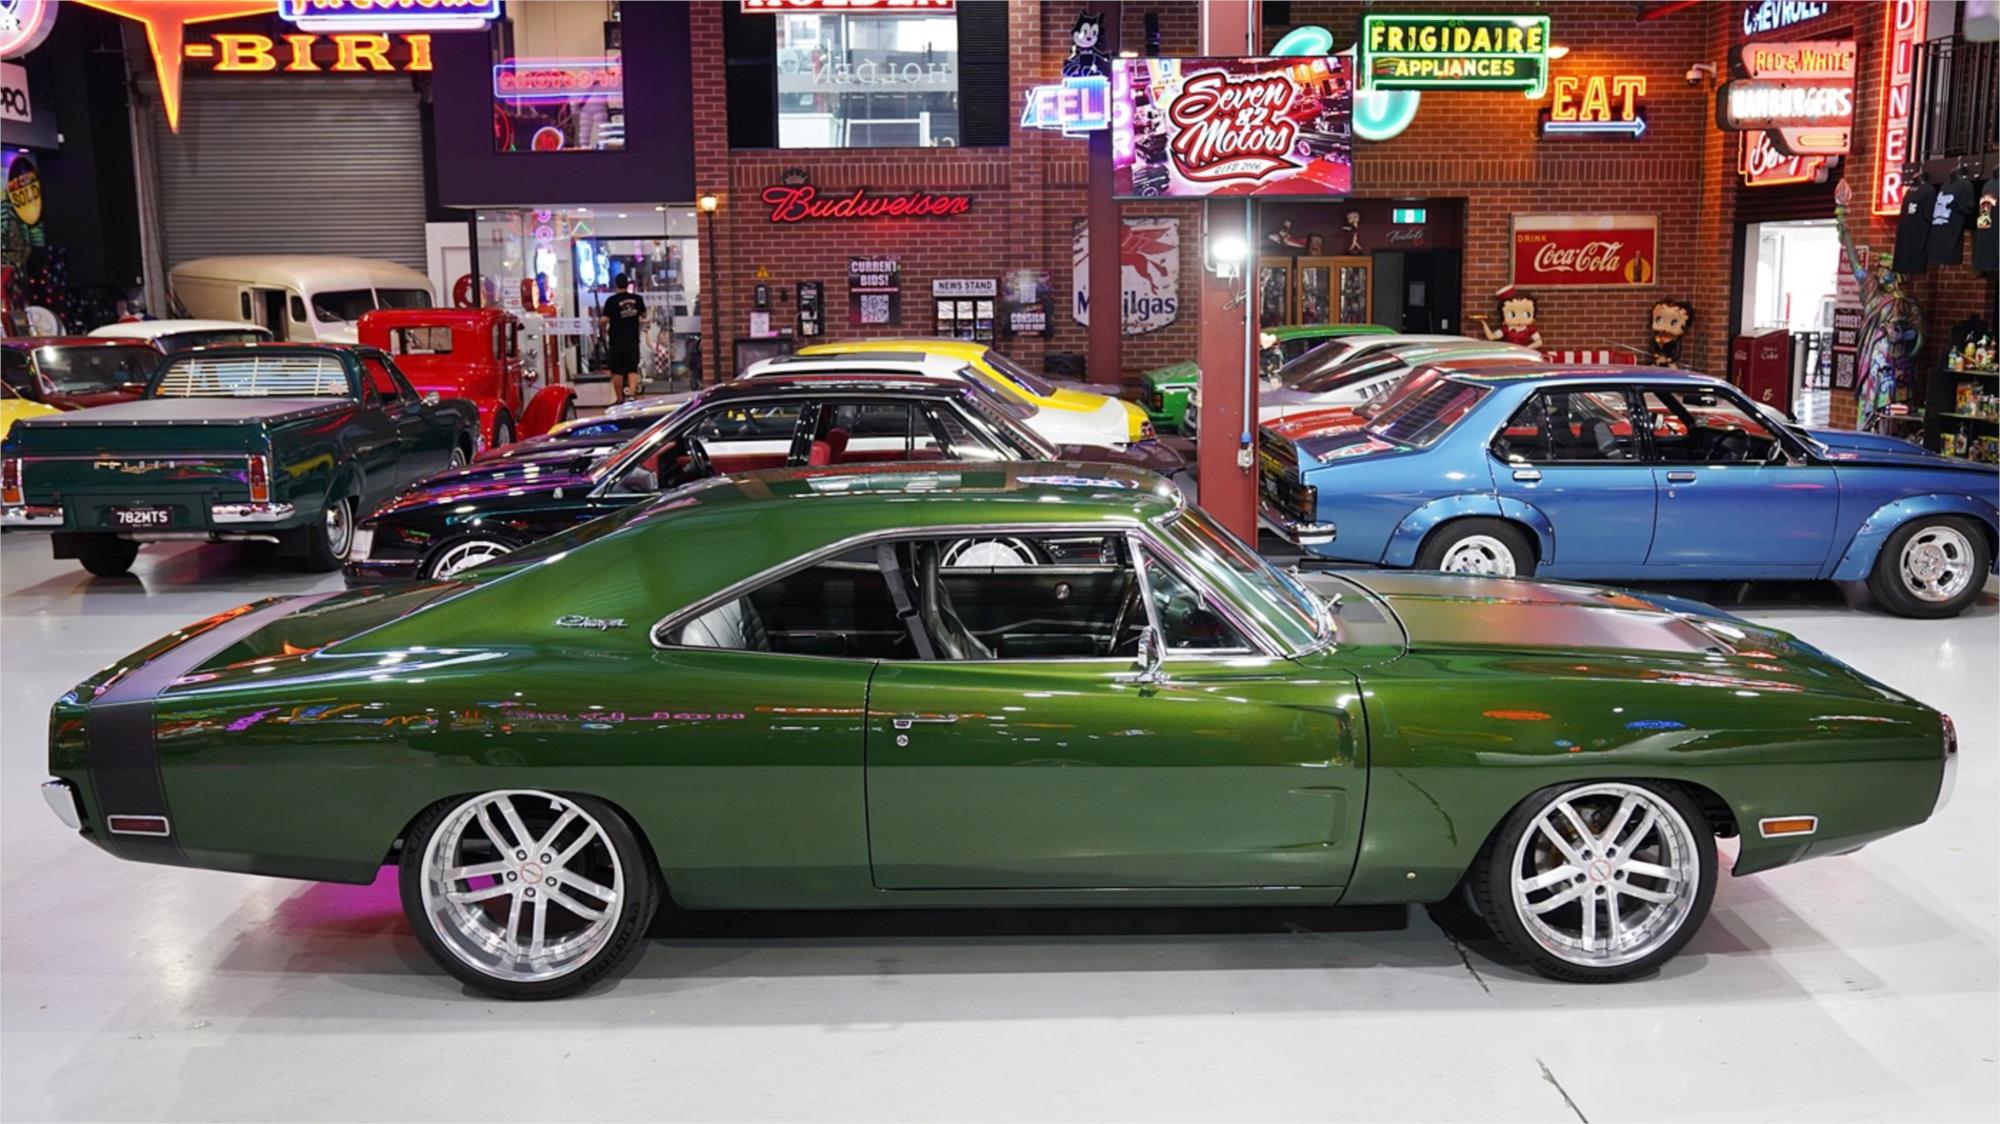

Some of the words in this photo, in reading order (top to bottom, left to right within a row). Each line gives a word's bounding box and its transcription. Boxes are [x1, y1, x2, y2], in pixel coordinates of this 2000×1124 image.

[1370, 26, 1543, 51] FRIGIDAIRE
[1394, 59, 1515, 77] APPLIANCES
[1755, 51, 1782, 71] RED
[1801, 49, 1850, 71] WHITE
[1175, 78, 1287, 125] Seven
[1552, 75, 1647, 121] EAT
[1882, 0, 1915, 206] DINER
[1235, 106, 1268, 126] 82
[1177, 117, 1290, 164] Motors
[761, 185, 970, 222] Budweiser
[1517, 234, 1547, 243] DRINK
[851, 260, 897, 273] CURRENT
[1533, 241, 1625, 273] Coca-Cola
[860, 274, 889, 287] BIDS!
[938, 281, 962, 290] NEWS
[965, 281, 992, 290] STAND
[1078, 290, 1176, 322] Milgas
[116, 510, 169, 524] 782MTS
